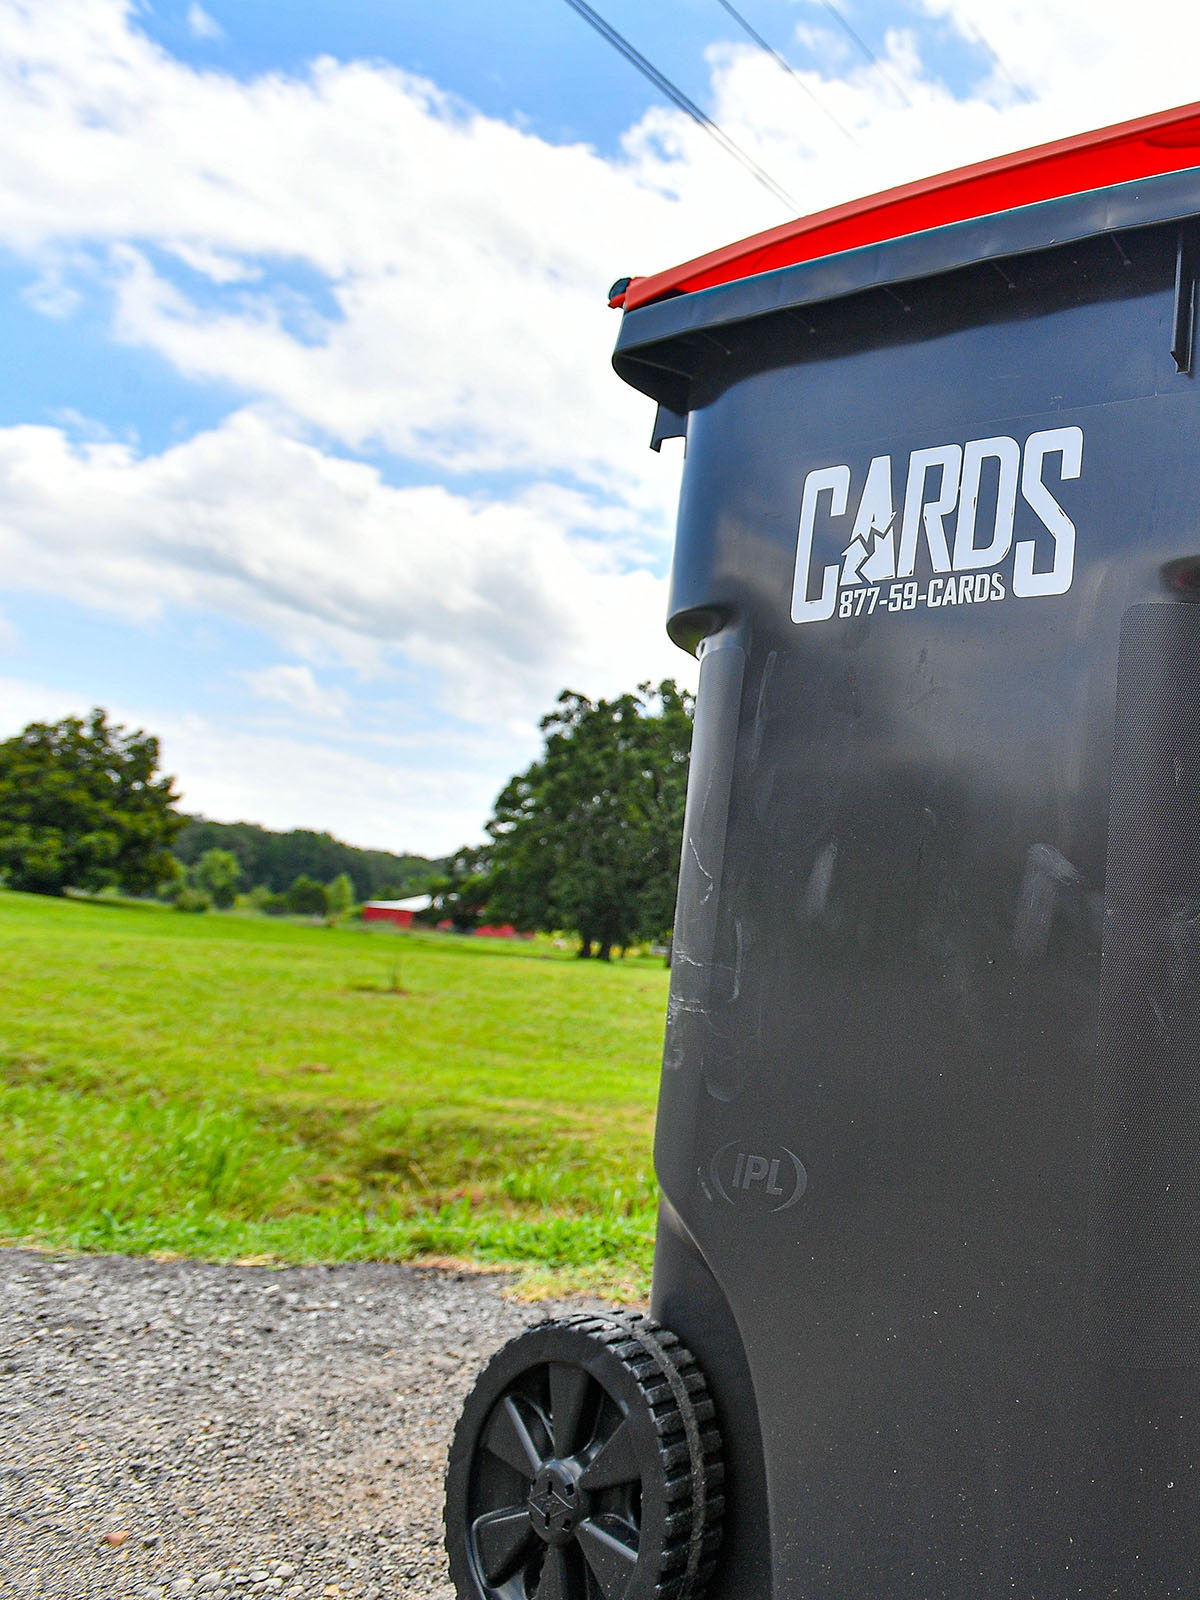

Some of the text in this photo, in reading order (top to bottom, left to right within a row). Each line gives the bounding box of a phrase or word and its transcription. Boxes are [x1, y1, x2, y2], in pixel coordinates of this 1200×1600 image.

[790, 425, 1084, 624] CARDS
[838, 573, 1006, 619] 877-59-CARDS
[732, 1152, 783, 1195] IPL
